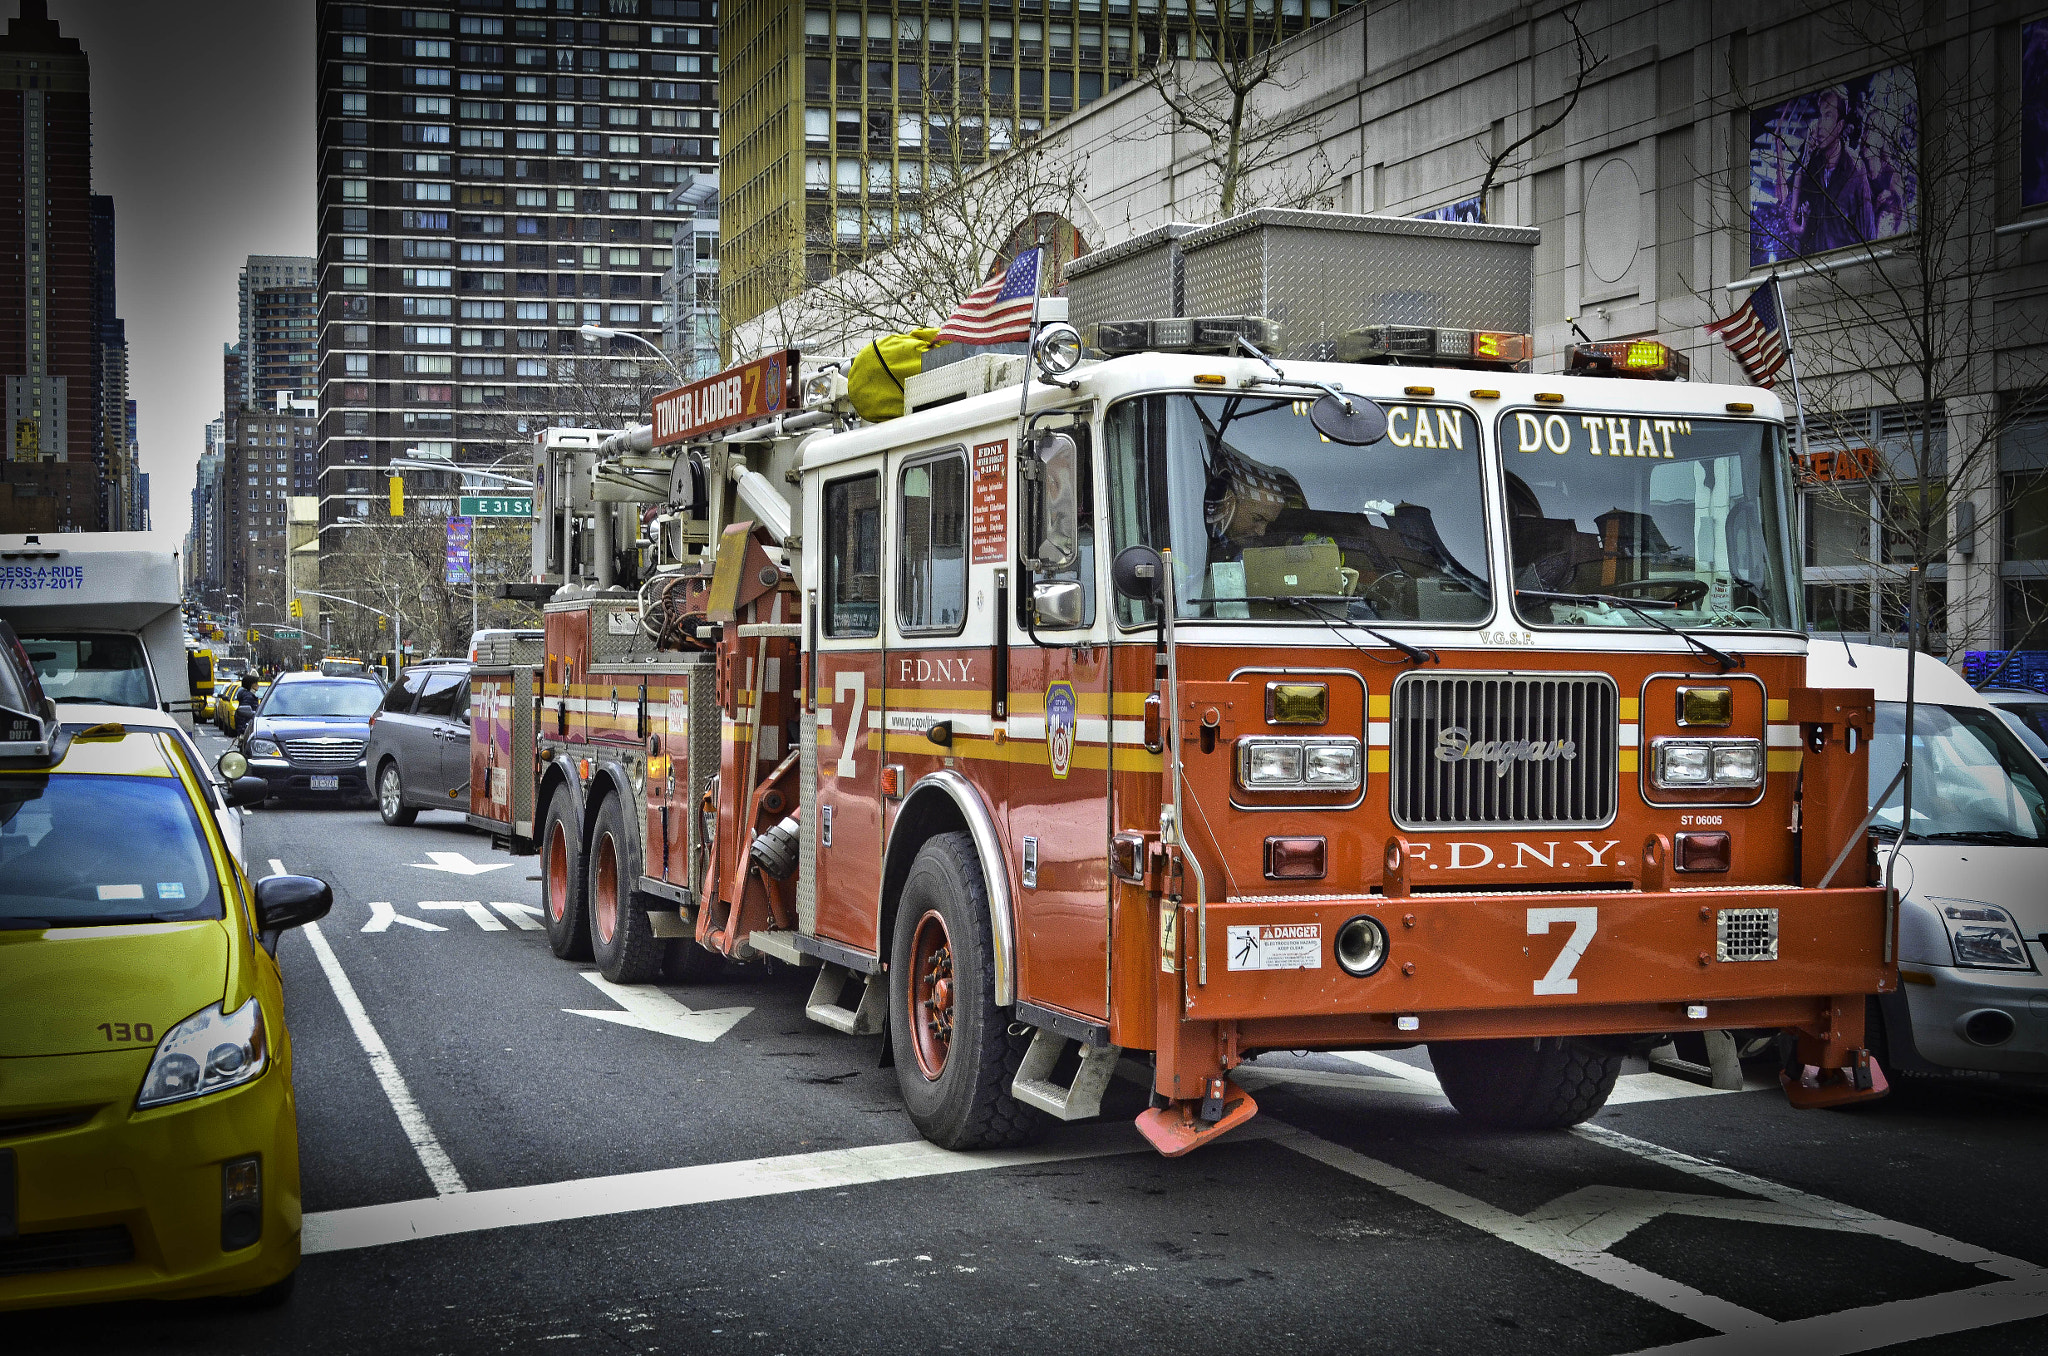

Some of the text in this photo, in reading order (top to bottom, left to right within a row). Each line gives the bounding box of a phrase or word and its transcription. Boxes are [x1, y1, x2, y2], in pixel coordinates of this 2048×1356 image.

[656, 365, 761, 438] TOWER LADDER 7
[1386, 405, 1463, 450] CAN
[1515, 413, 1571, 455] DO
[978, 444, 1003, 457] FDNY
[479, 501, 531, 512] E 31 St
[1479, 631, 1535, 645] V.G.S.F.
[900, 658, 975, 682] F.D.N.Y.
[670, 692, 683, 709] FAST
[13, 720, 29, 730] OFF
[835, 672, 865, 778] 7
[9, 730, 32, 740] DUTY
[1434, 726, 1577, 778] Seagrave
[1681, 815, 1722, 825] ST 06005
[1274, 926, 1318, 938] DANGER
[1526, 906, 1598, 996] 7
[97, 1022, 154, 1042] 130
